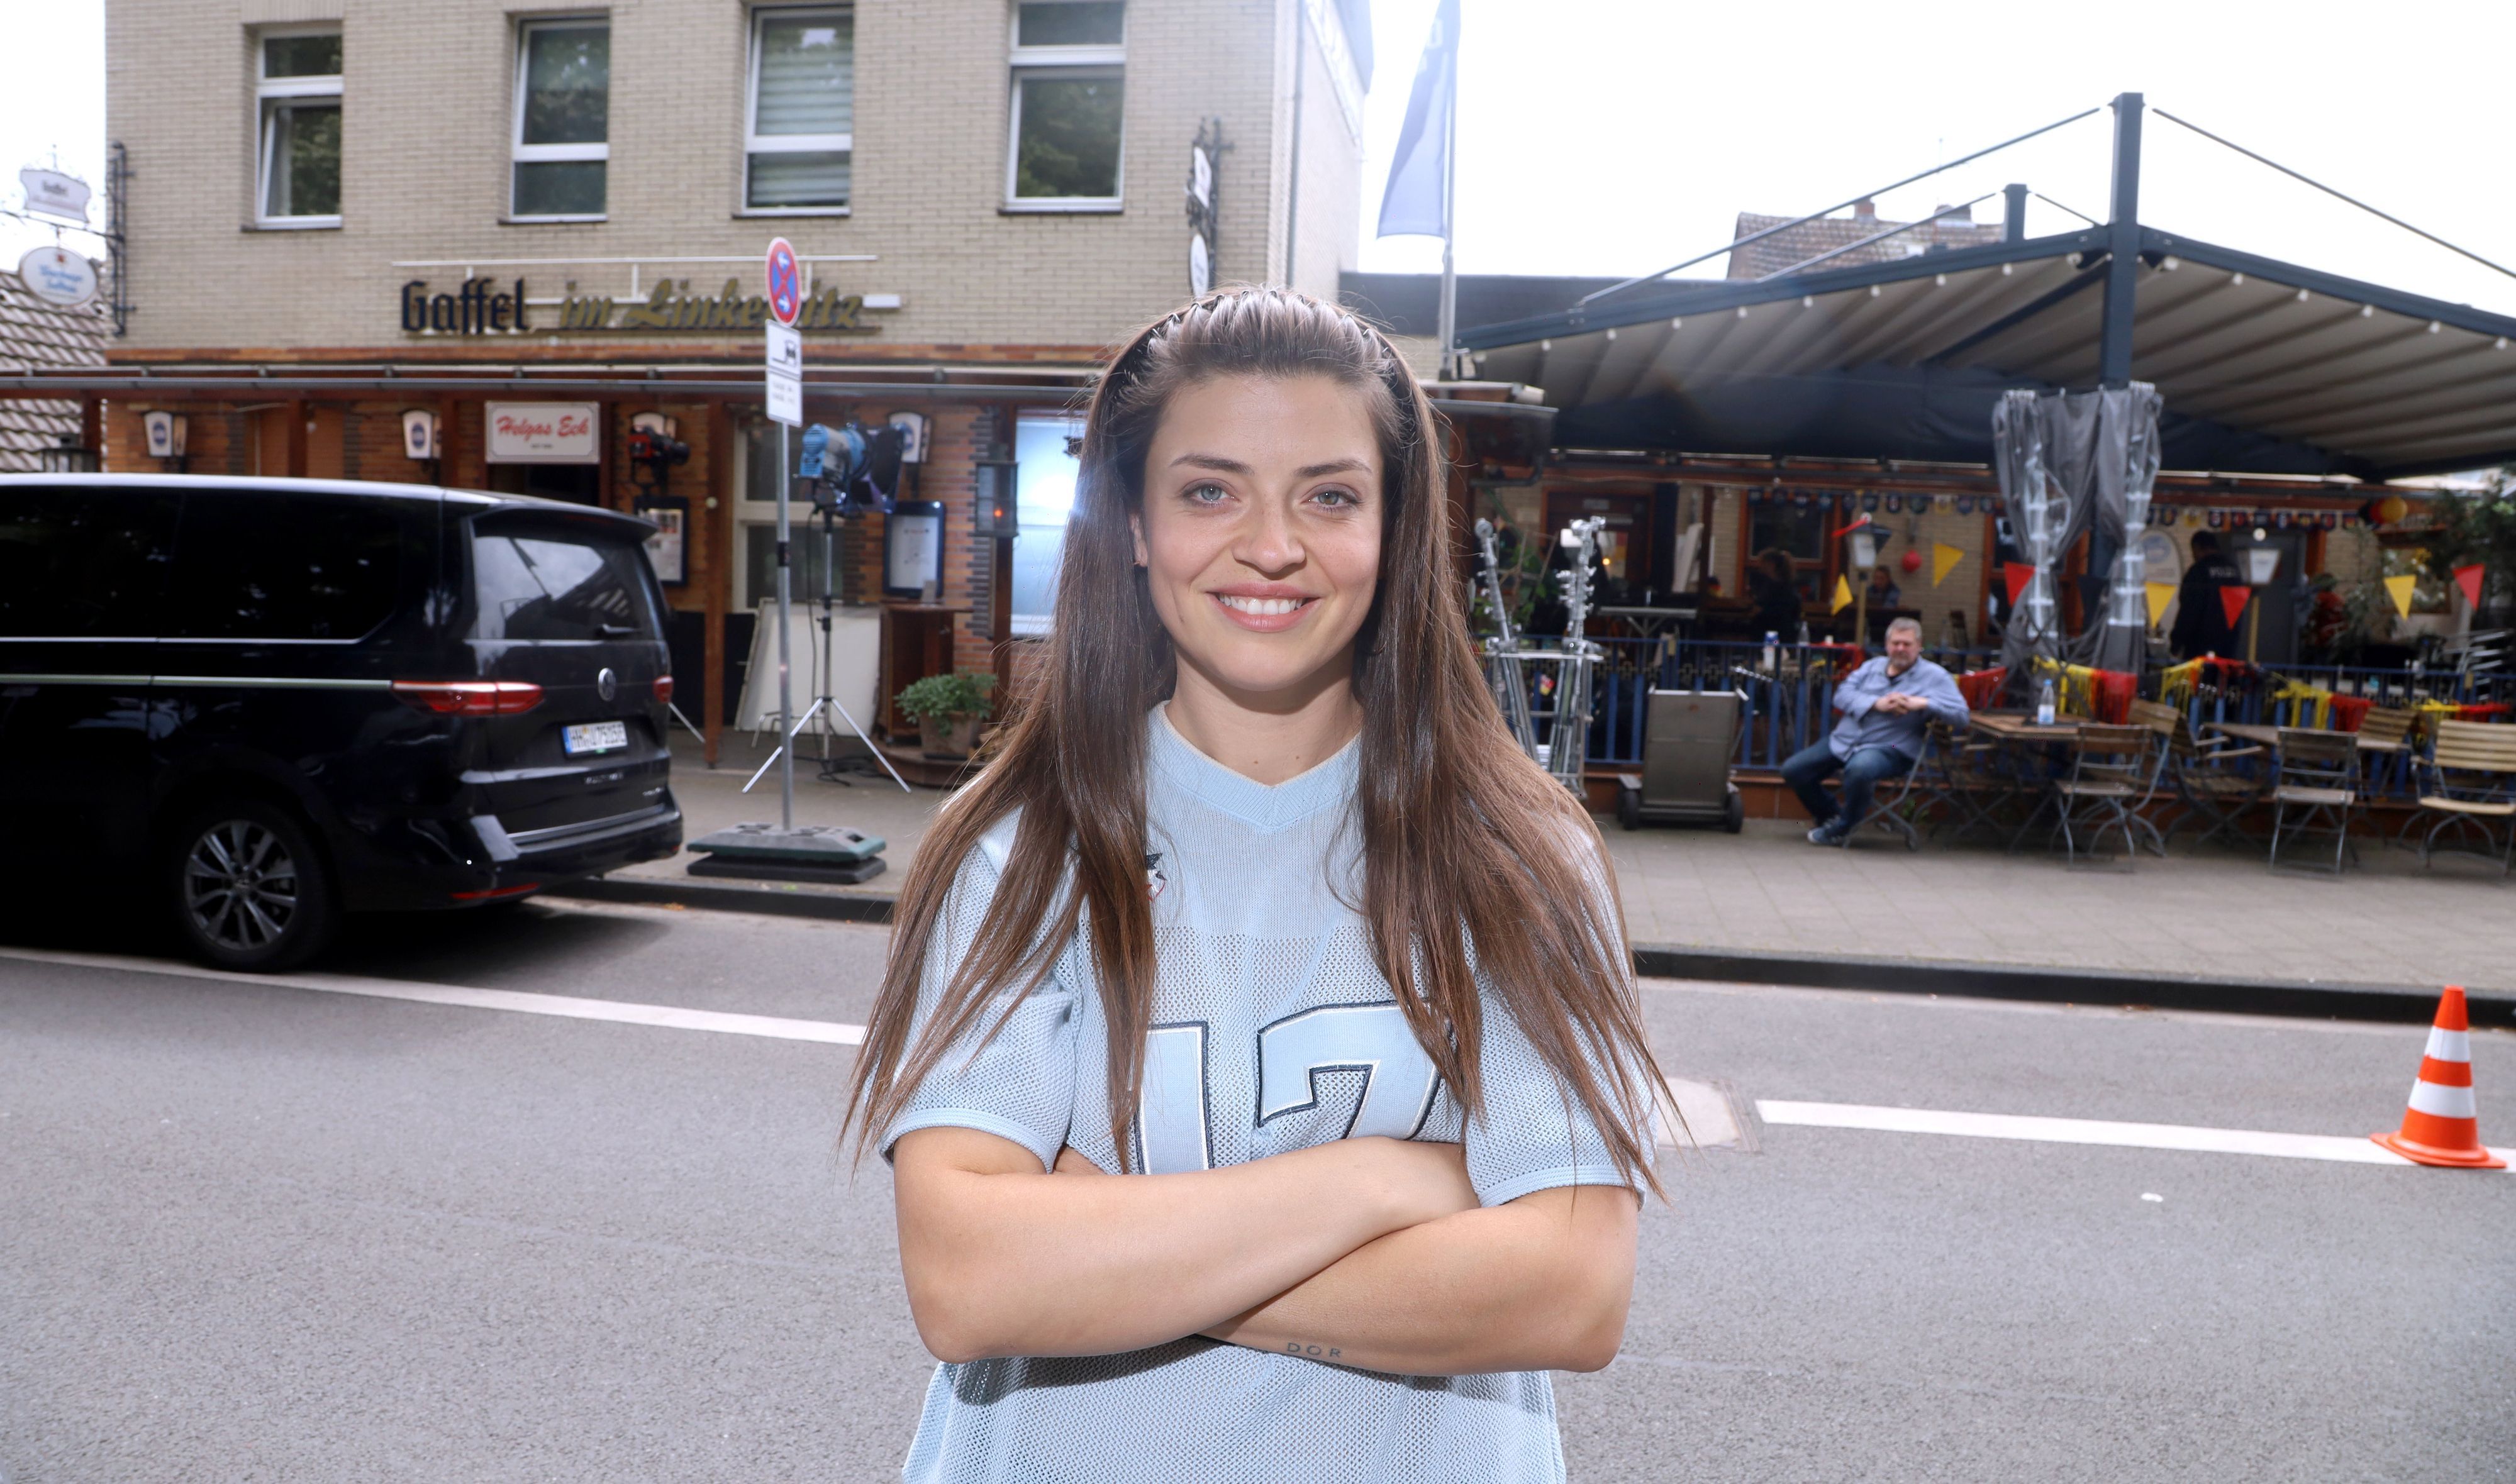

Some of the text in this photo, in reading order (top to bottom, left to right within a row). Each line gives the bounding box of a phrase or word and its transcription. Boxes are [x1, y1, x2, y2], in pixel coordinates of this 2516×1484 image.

[401, 277, 863, 336] Gaffel im Linkeitz
[496, 414, 589, 441] Helgas Eck
[1287, 1342, 1342, 1358] DOR
